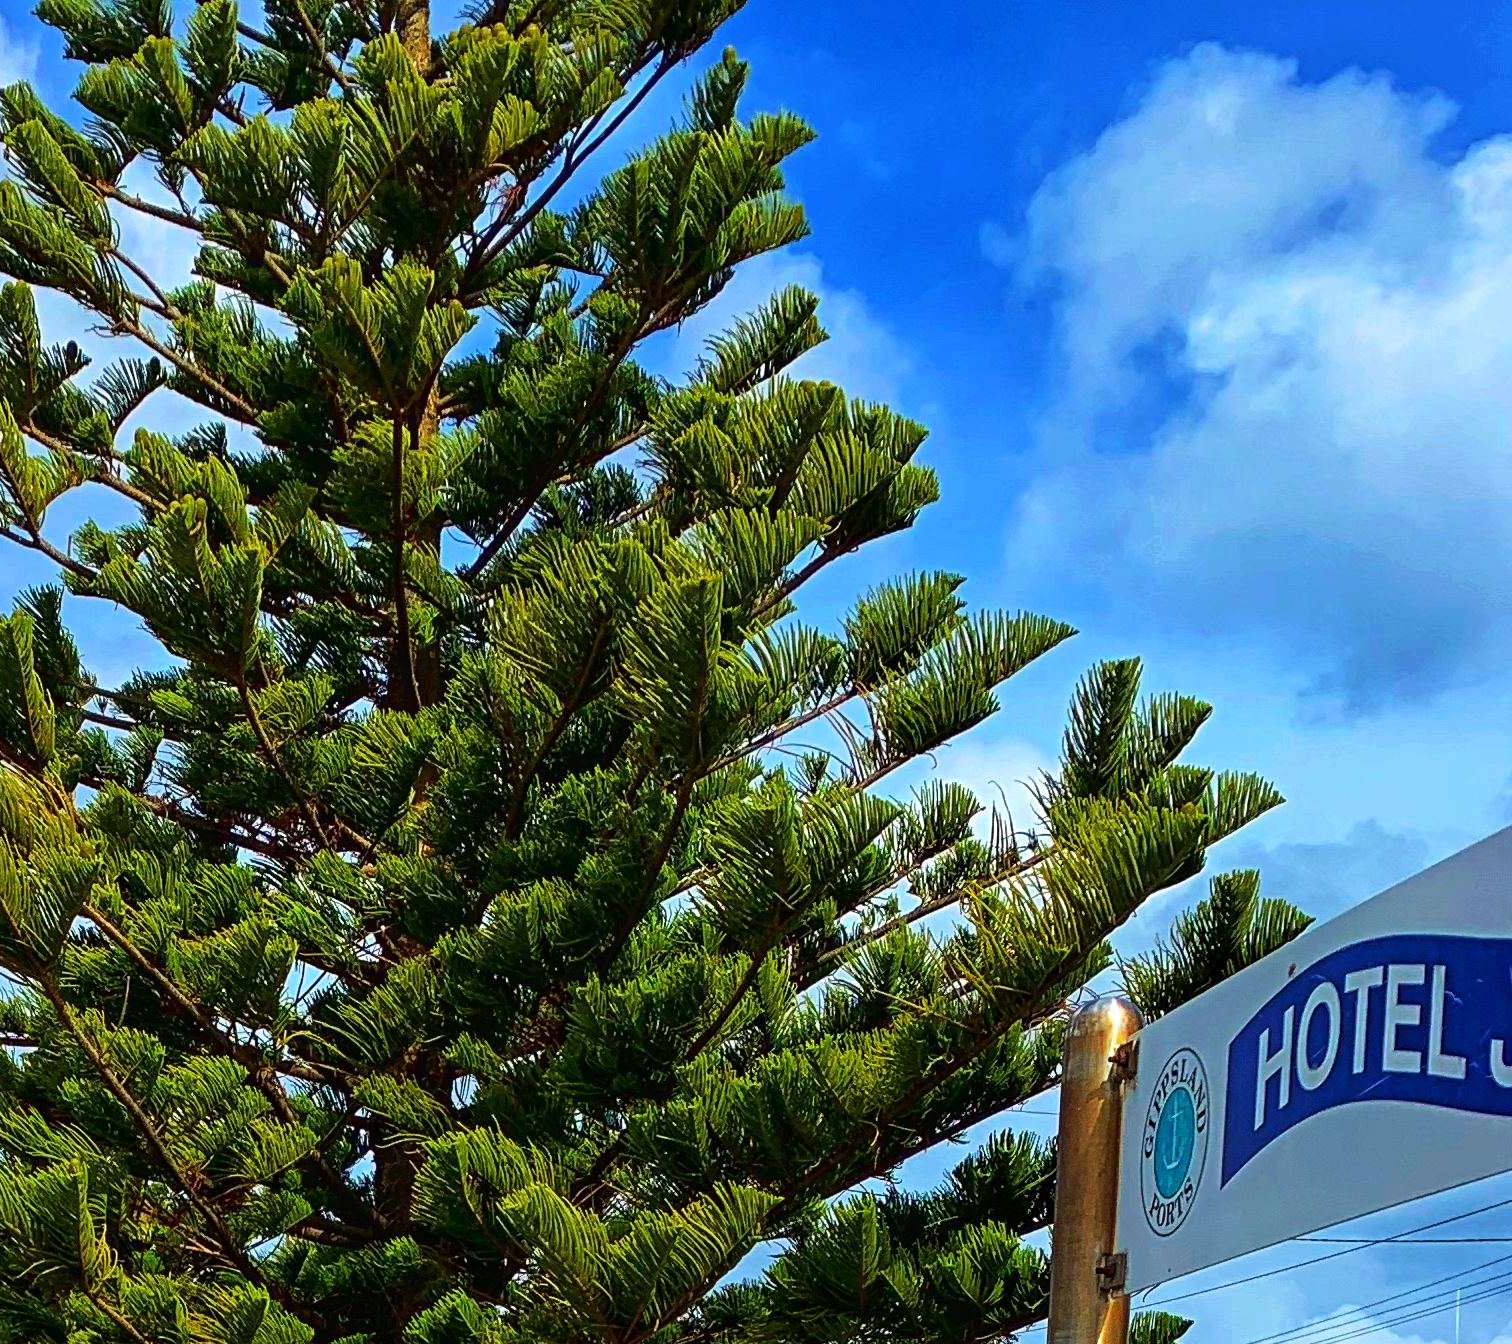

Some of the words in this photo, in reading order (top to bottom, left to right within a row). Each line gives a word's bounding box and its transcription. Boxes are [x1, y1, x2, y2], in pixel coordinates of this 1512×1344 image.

[1253, 963, 1467, 1132] HOTEL
[1144, 1058, 1207, 1159] GIPPSLAND
[1149, 1176, 1194, 1228] PORTS
